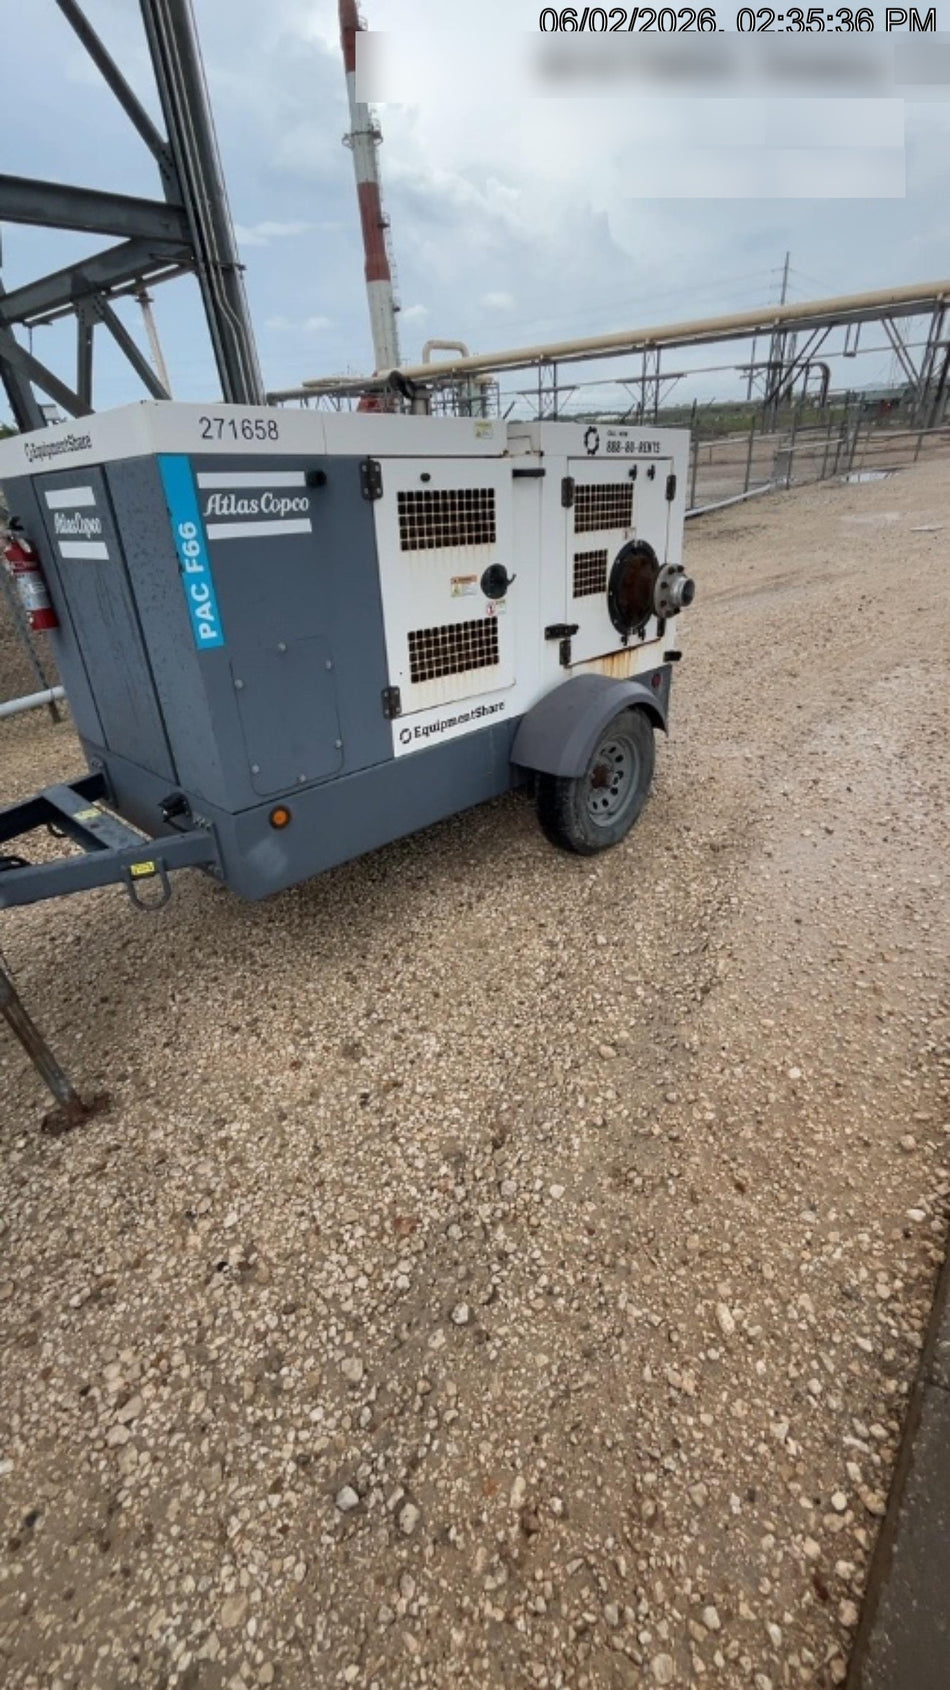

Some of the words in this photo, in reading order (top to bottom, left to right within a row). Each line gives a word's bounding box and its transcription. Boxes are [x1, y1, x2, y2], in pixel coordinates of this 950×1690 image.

[199, 416, 279, 440] 271658
[203, 493, 259, 517] Atlas
[260, 491, 309, 517] Copco
[178, 521, 204, 573] F66
[190, 582, 217, 639] PAC
[414, 702, 505, 738] EquipmentShare
